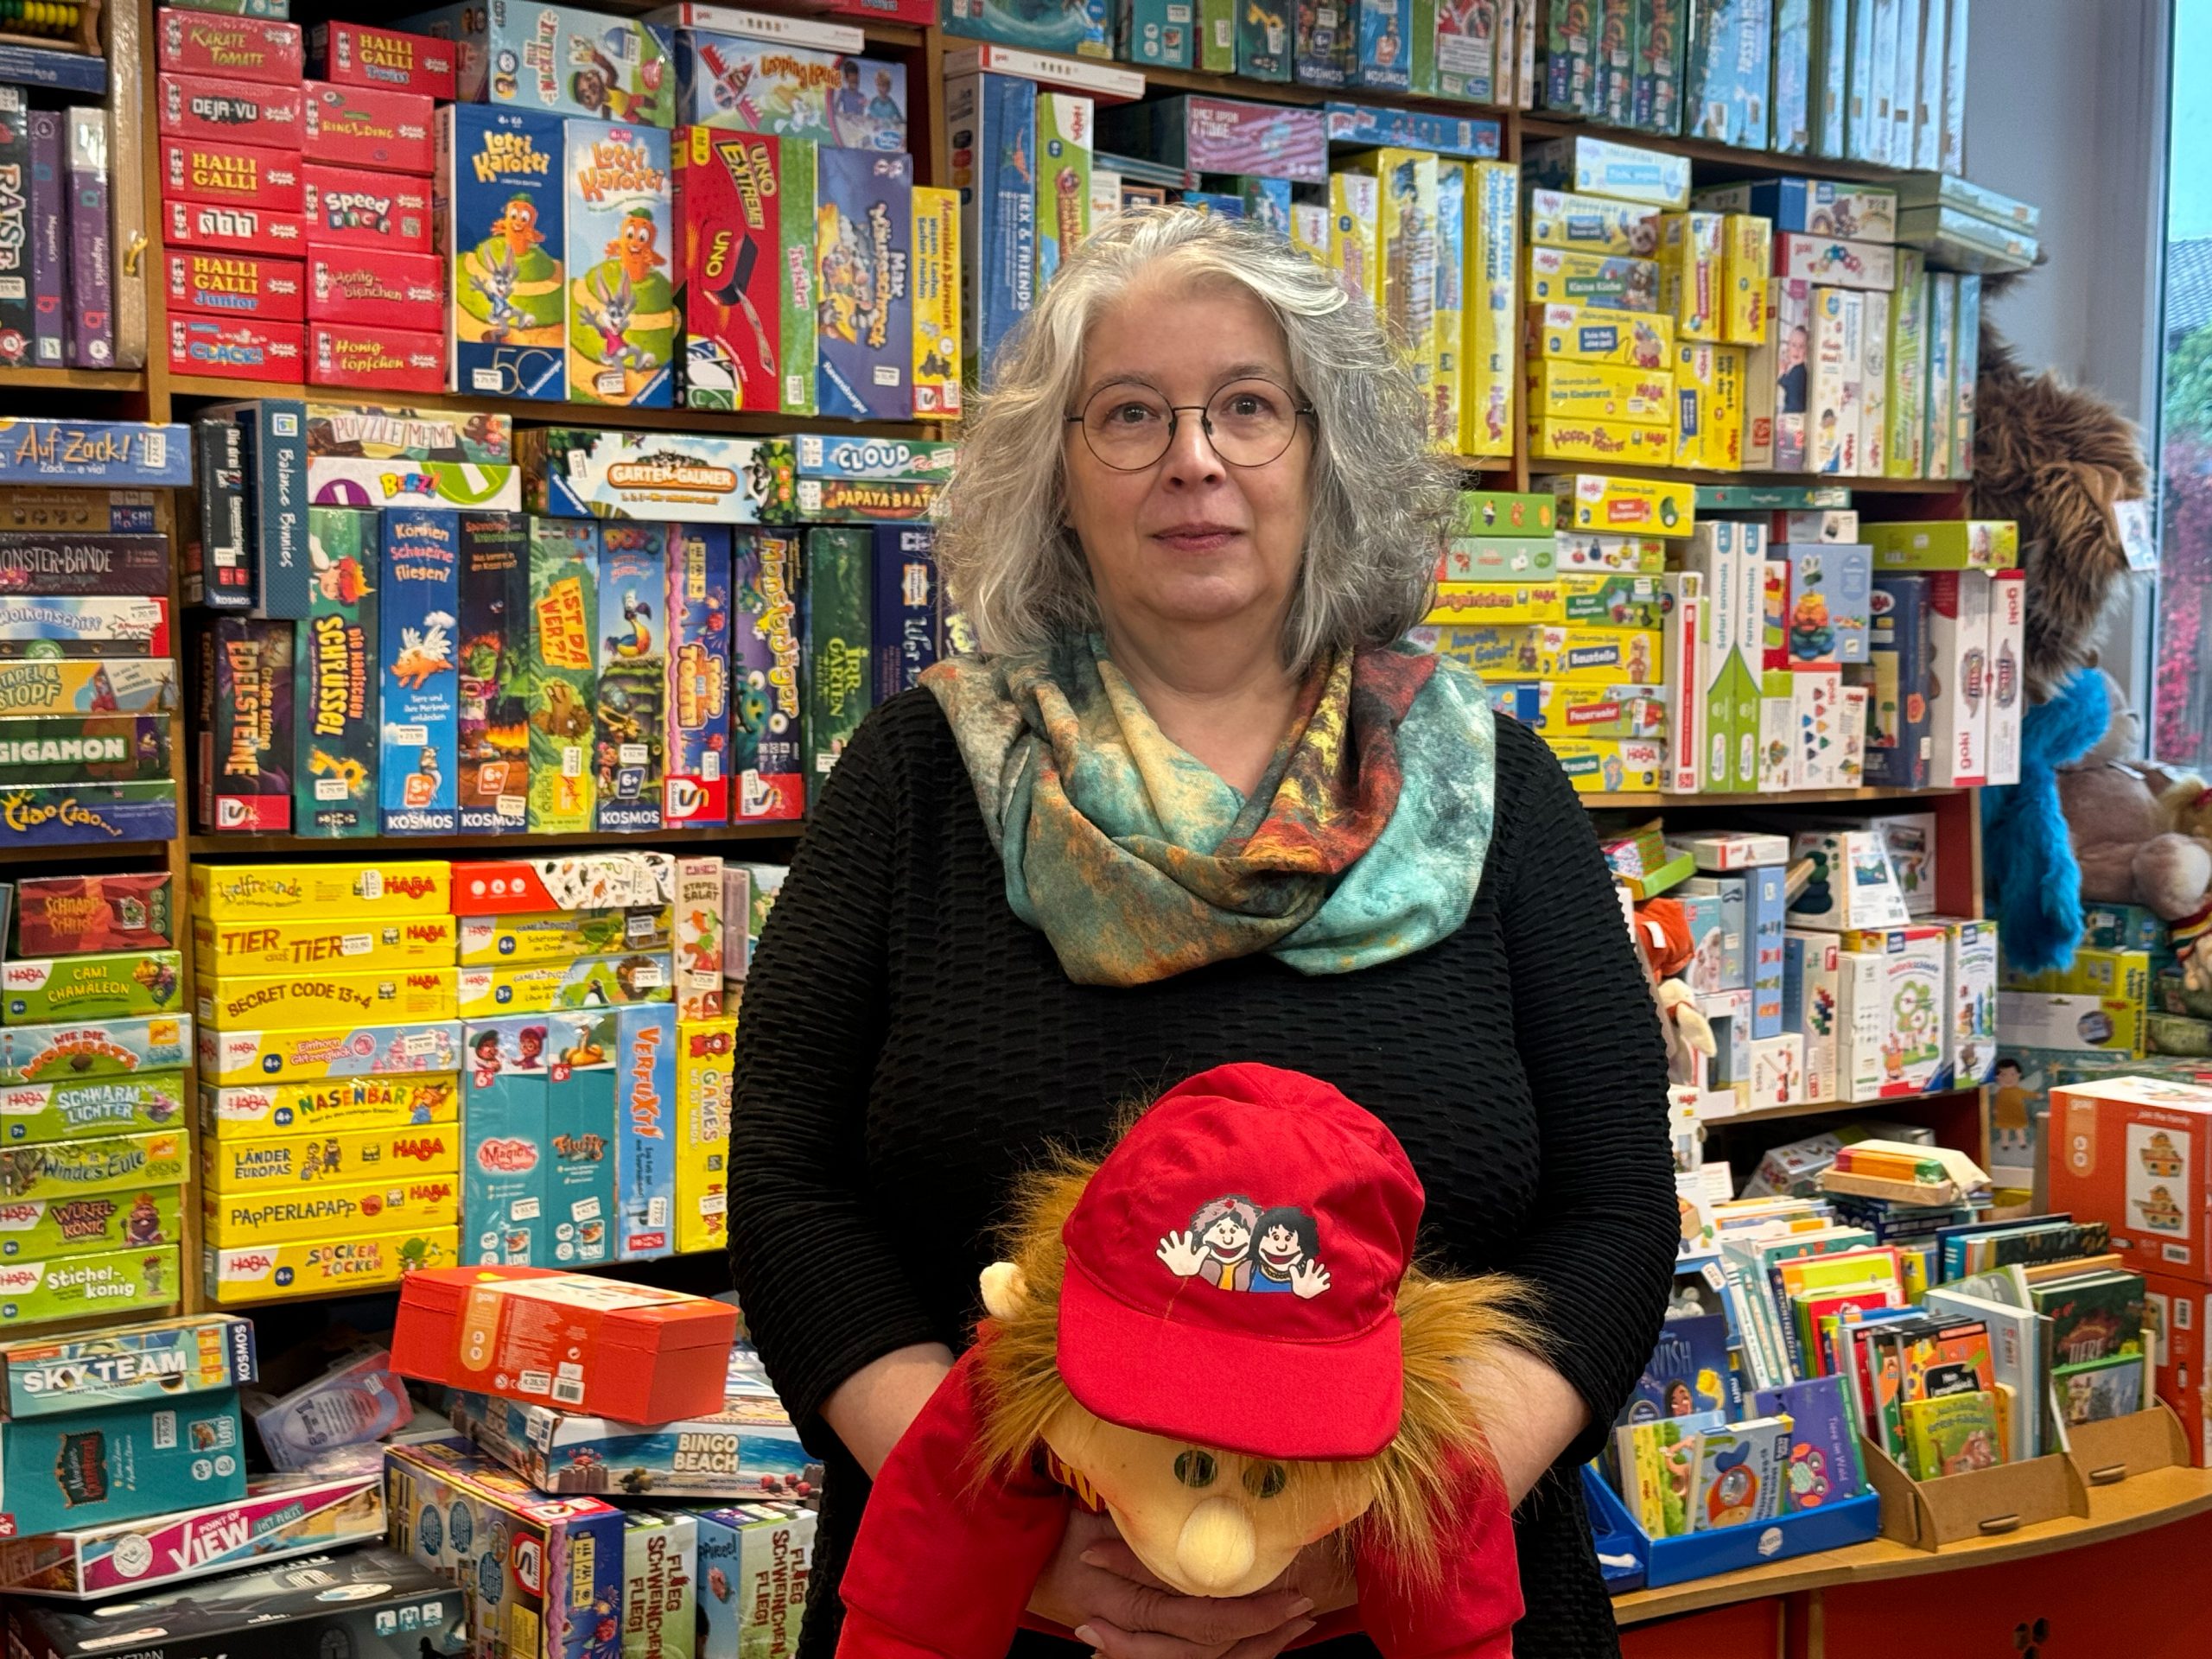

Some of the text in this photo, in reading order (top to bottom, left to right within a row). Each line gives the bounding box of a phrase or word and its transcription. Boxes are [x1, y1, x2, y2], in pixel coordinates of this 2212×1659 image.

[359, 33, 413, 55] HALLI
[210, 46, 264, 67] TOMATE
[359, 49, 414, 70] GALLI
[484, 130, 533, 154] Lotti
[192, 152, 257, 174] HALLI
[591, 141, 646, 171] Lotti
[471, 152, 552, 184] Karotti
[748, 142, 778, 197] UNO
[192, 171, 258, 192] GALLI
[578, 168, 665, 202] Karotti
[324, 192, 391, 216] Speed
[706, 230, 734, 277] UNO
[1017, 193, 1033, 313] REX & FRIENDS
[194, 257, 258, 277] HALLI
[889, 251, 907, 299] Max
[194, 275, 259, 296] GALLI
[194, 290, 258, 310] Junior
[190, 341, 264, 365] CLACK!
[334, 339, 385, 356] Honig-
[340, 353, 404, 373] töpfchen
[15, 423, 132, 465] Auf Zack!
[226, 429, 241, 468] Die drei
[837, 444, 911, 470] CLOUD
[279, 448, 296, 507] Balance
[612, 465, 732, 485] GARTEN-GAUNER
[836, 490, 891, 507] PAPAYA
[394, 523, 450, 542] Können
[66, 544, 113, 573] BANDE
[389, 543, 454, 563] Schweine
[394, 563, 452, 583] fliegen?
[2006, 586, 2020, 626] goki
[760, 538, 802, 719] Monsterjäger
[1571, 649, 1618, 665] Baustelle
[828, 638, 848, 718] GARTEN
[224, 641, 261, 776] EDELSTEINE
[1568, 706, 1619, 721] Feuerwehr
[1959, 731, 1973, 770] goki
[387, 813, 454, 830] KOSMOS
[461, 813, 526, 829] KOSMOS
[601, 810, 660, 825] KOSMOS
[383, 875, 437, 899] HABA
[683, 881, 720, 893] STAPEL
[683, 891, 721, 904] SALAT
[405, 925, 448, 944] HABA
[221, 928, 282, 956] TIER
[289, 934, 346, 964] TIER
[8, 968, 47, 983] HABA
[72, 966, 108, 982] CAMI
[406, 974, 442, 990] HABA
[48, 981, 130, 1003] CHAMÄLEON
[226, 982, 372, 1018] SECRET CODE 13+4
[228, 1041, 258, 1055] HABA
[296, 1036, 341, 1052] Einhorn
[264, 1057, 282, 1069] 4+
[8, 1090, 48, 1107] HABA
[56, 1084, 142, 1109] SCHWARM
[232, 1094, 271, 1111] HABA
[297, 1085, 408, 1116] NASENBÄR
[700, 1068, 721, 1143] GAMES
[67, 1104, 133, 1123] LICHTER
[276, 1111, 293, 1122] 4+
[234, 1146, 293, 1166] LÄNDER
[392, 1137, 447, 1162] HABA
[234, 1163, 293, 1180] EUROPAS
[409, 1183, 452, 1204] HABA
[0, 1205, 40, 1222] HABA
[62, 1219, 107, 1239] KÖNIG
[230, 1255, 272, 1273] HABA
[305, 1243, 378, 1268] SOCKEN
[0, 1270, 38, 1285] HABA
[46, 1264, 122, 1291] Stichel-
[276, 1271, 293, 1281] 4+
[321, 1260, 383, 1278] ZOCKEN
[84, 1278, 137, 1300] könig
[233, 1324, 252, 1382] KOSMOS
[22, 1350, 188, 1394] SKY TEAM
[677, 1433, 739, 1452] BINGO
[673, 1451, 740, 1472] BEACH
[198, 1510, 241, 1535] POINT OF
[168, 1516, 253, 1572] VIEW
